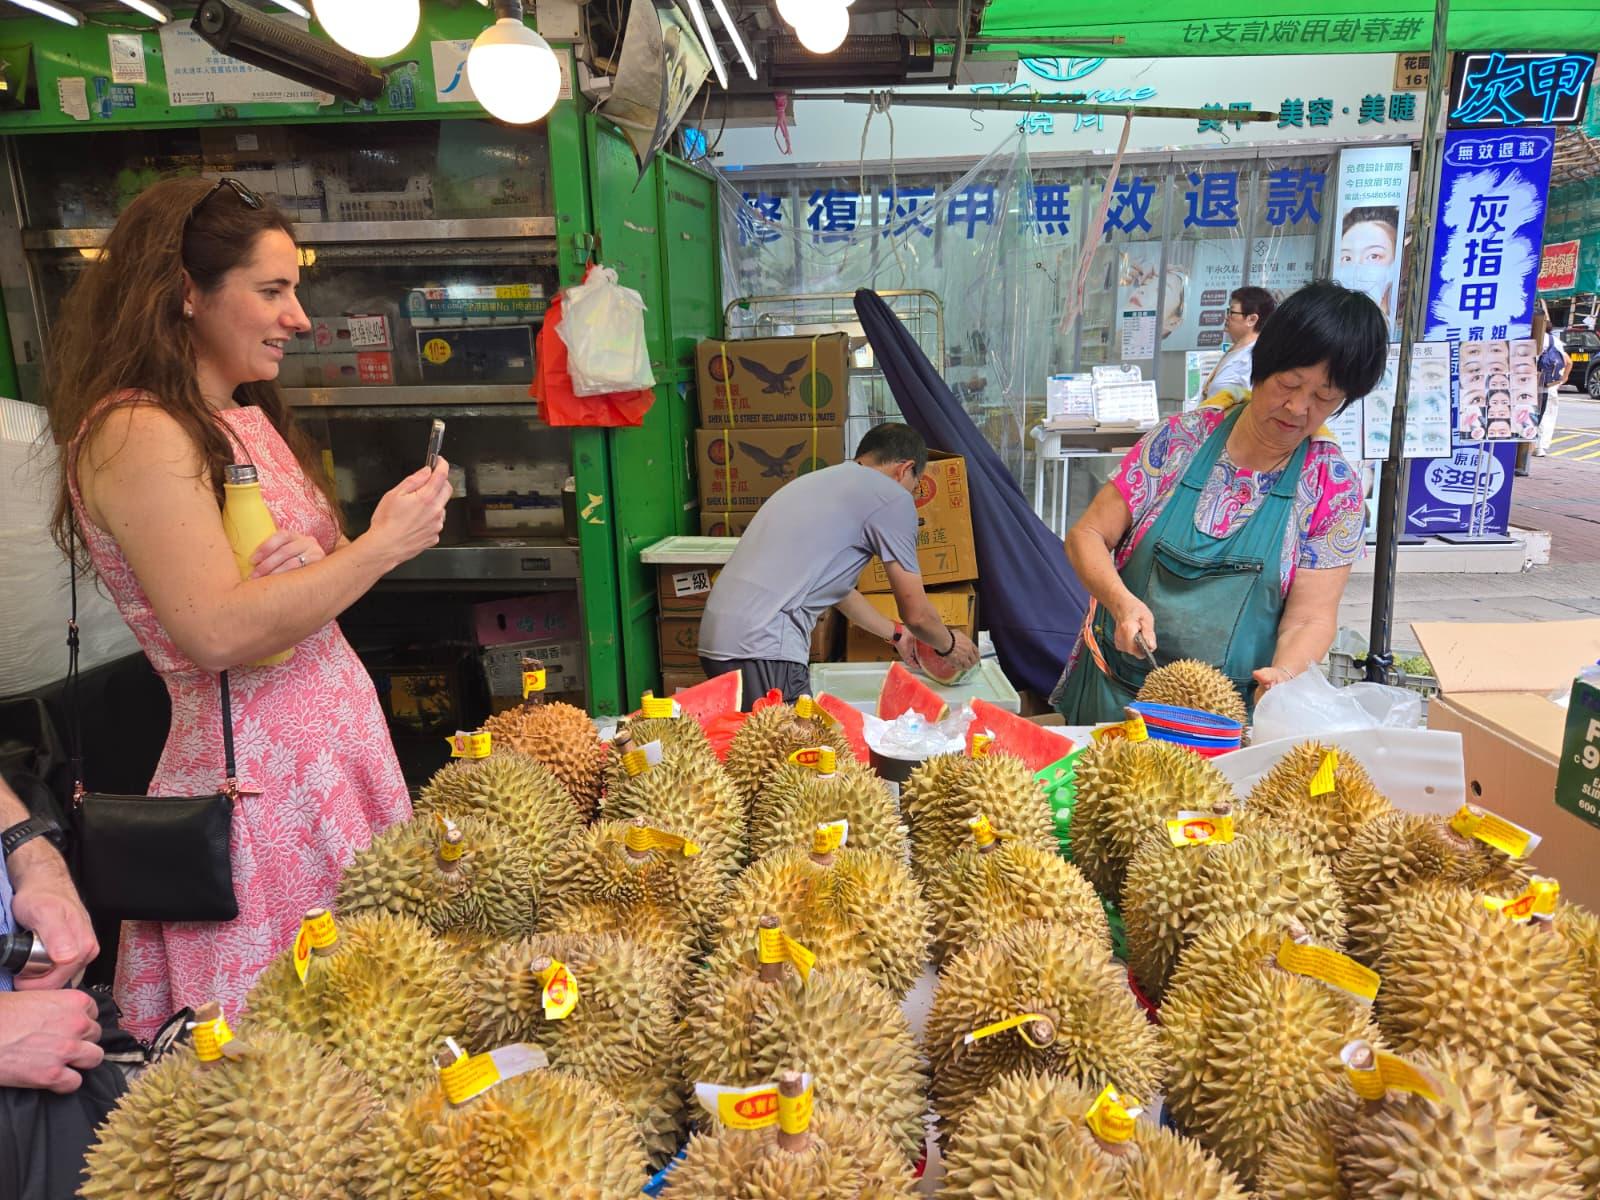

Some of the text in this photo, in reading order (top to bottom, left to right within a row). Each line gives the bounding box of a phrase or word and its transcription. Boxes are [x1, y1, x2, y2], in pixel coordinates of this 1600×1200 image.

[1404, 55, 1431, 70] 花園
[1451, 53, 1595, 125] 灰甲
[1457, 141, 1535, 161] 無效退款
[1458, 193, 1510, 321] 灰指甲
[1445, 324, 1507, 342] 三家姐
[676, 573, 708, 591] 二級
